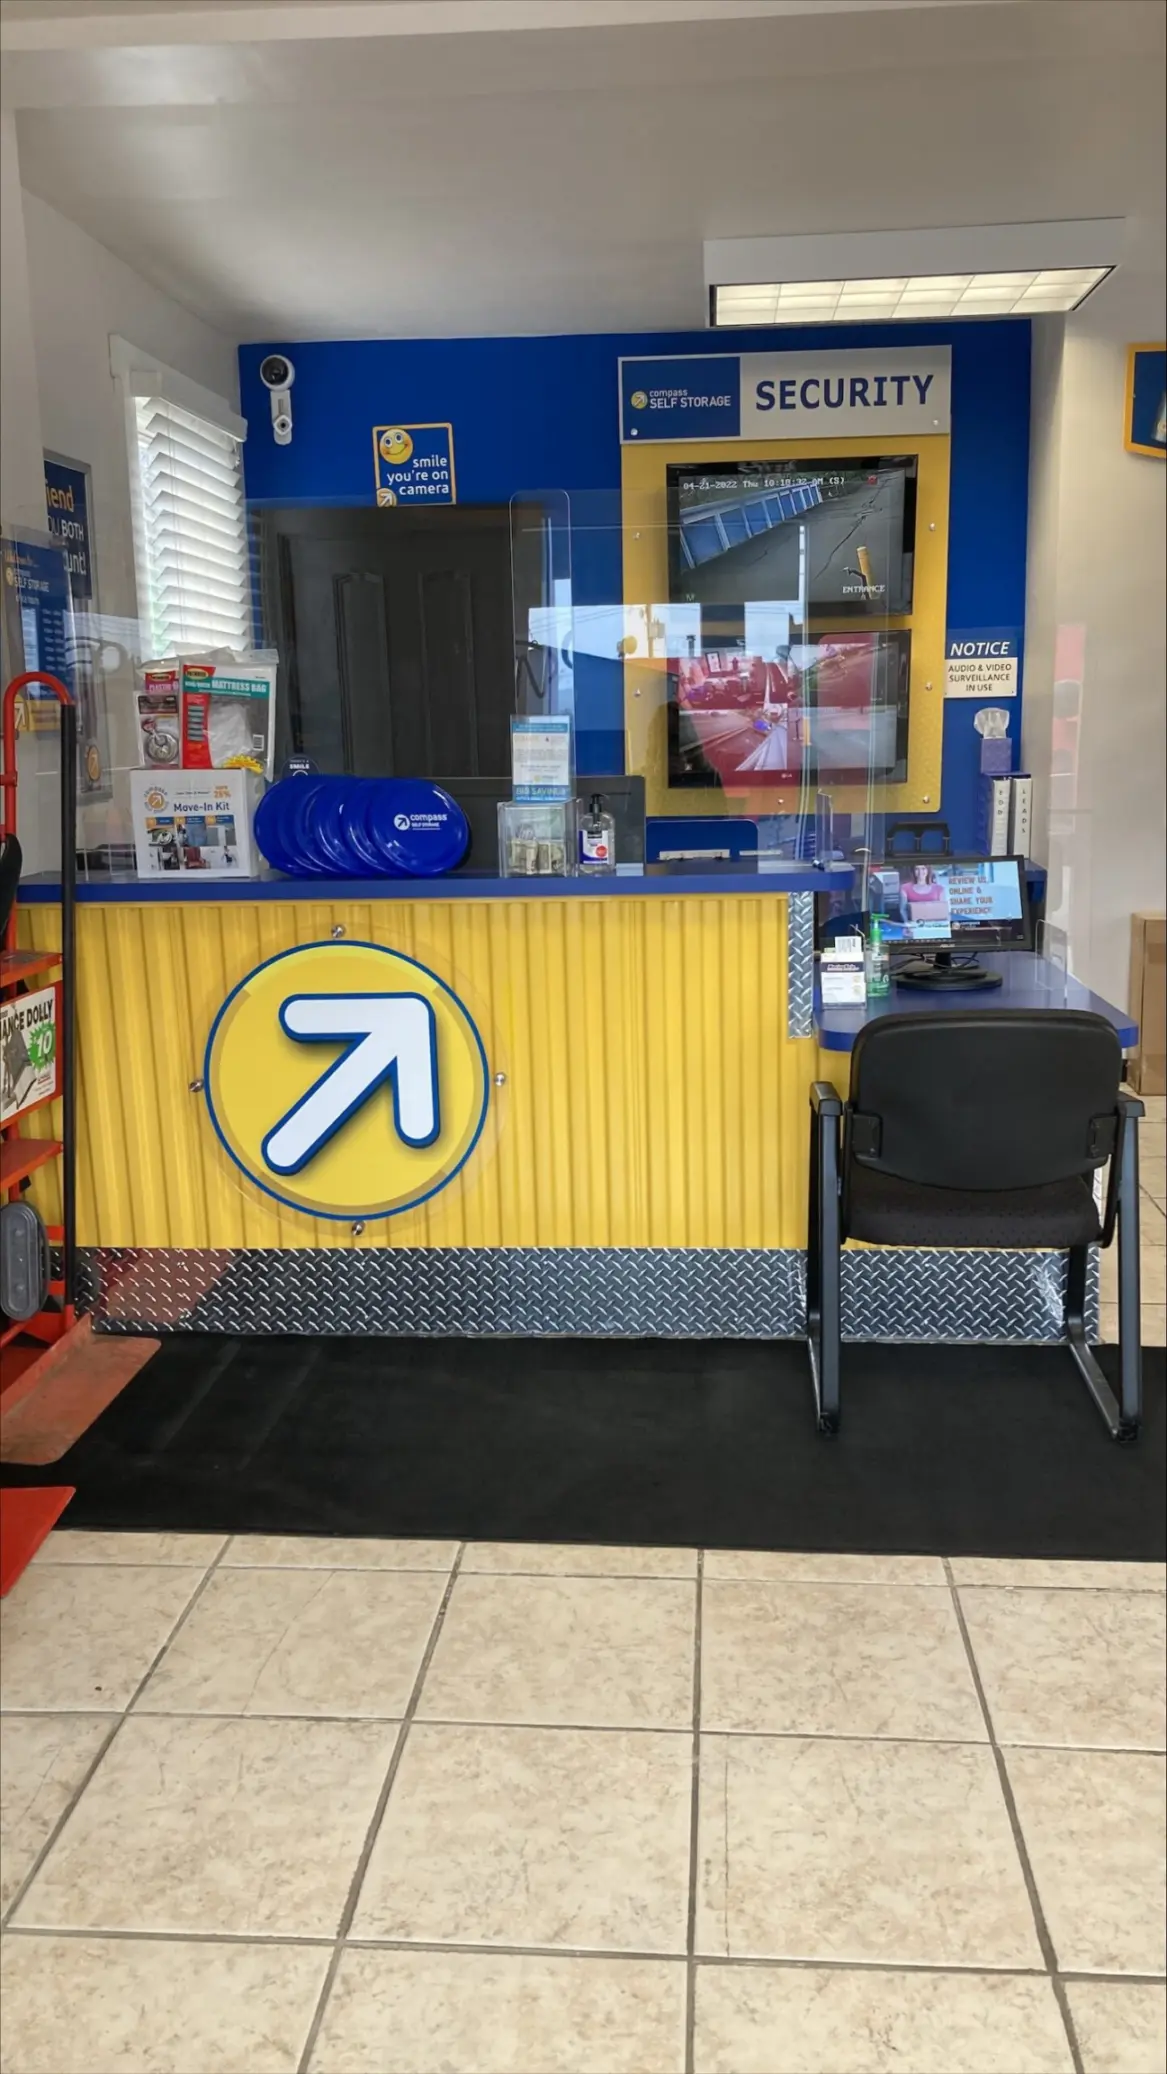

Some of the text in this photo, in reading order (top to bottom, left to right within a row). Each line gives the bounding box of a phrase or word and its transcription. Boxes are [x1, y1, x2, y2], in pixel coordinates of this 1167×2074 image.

[649, 388, 688, 400] compass
[755, 374, 934, 411] SECURITY
[649, 396, 731, 409] SELF STORAGE
[412, 454, 448, 468] smile
[386, 470, 449, 486] you're on
[399, 484, 449, 495] camera
[743, 480, 759, 488] Thu
[45, 484, 74, 513] iend
[62, 521, 84, 541] BOTH
[842, 585, 885, 594] ENTRANCE
[950, 642, 1010, 656] NOTICE
[948, 663, 1012, 673] AUDIO & VIDEO
[949, 674, 1010, 682] SURVEILLANCE
[966, 684, 992, 692] IN USE
[173, 802, 213, 812] Move-In
[216, 802, 230, 810] Kit
[410, 813, 447, 823] compass
[949, 875, 975, 885] REVIEW
[0, 999, 53, 1041] ANCE DOLLY
